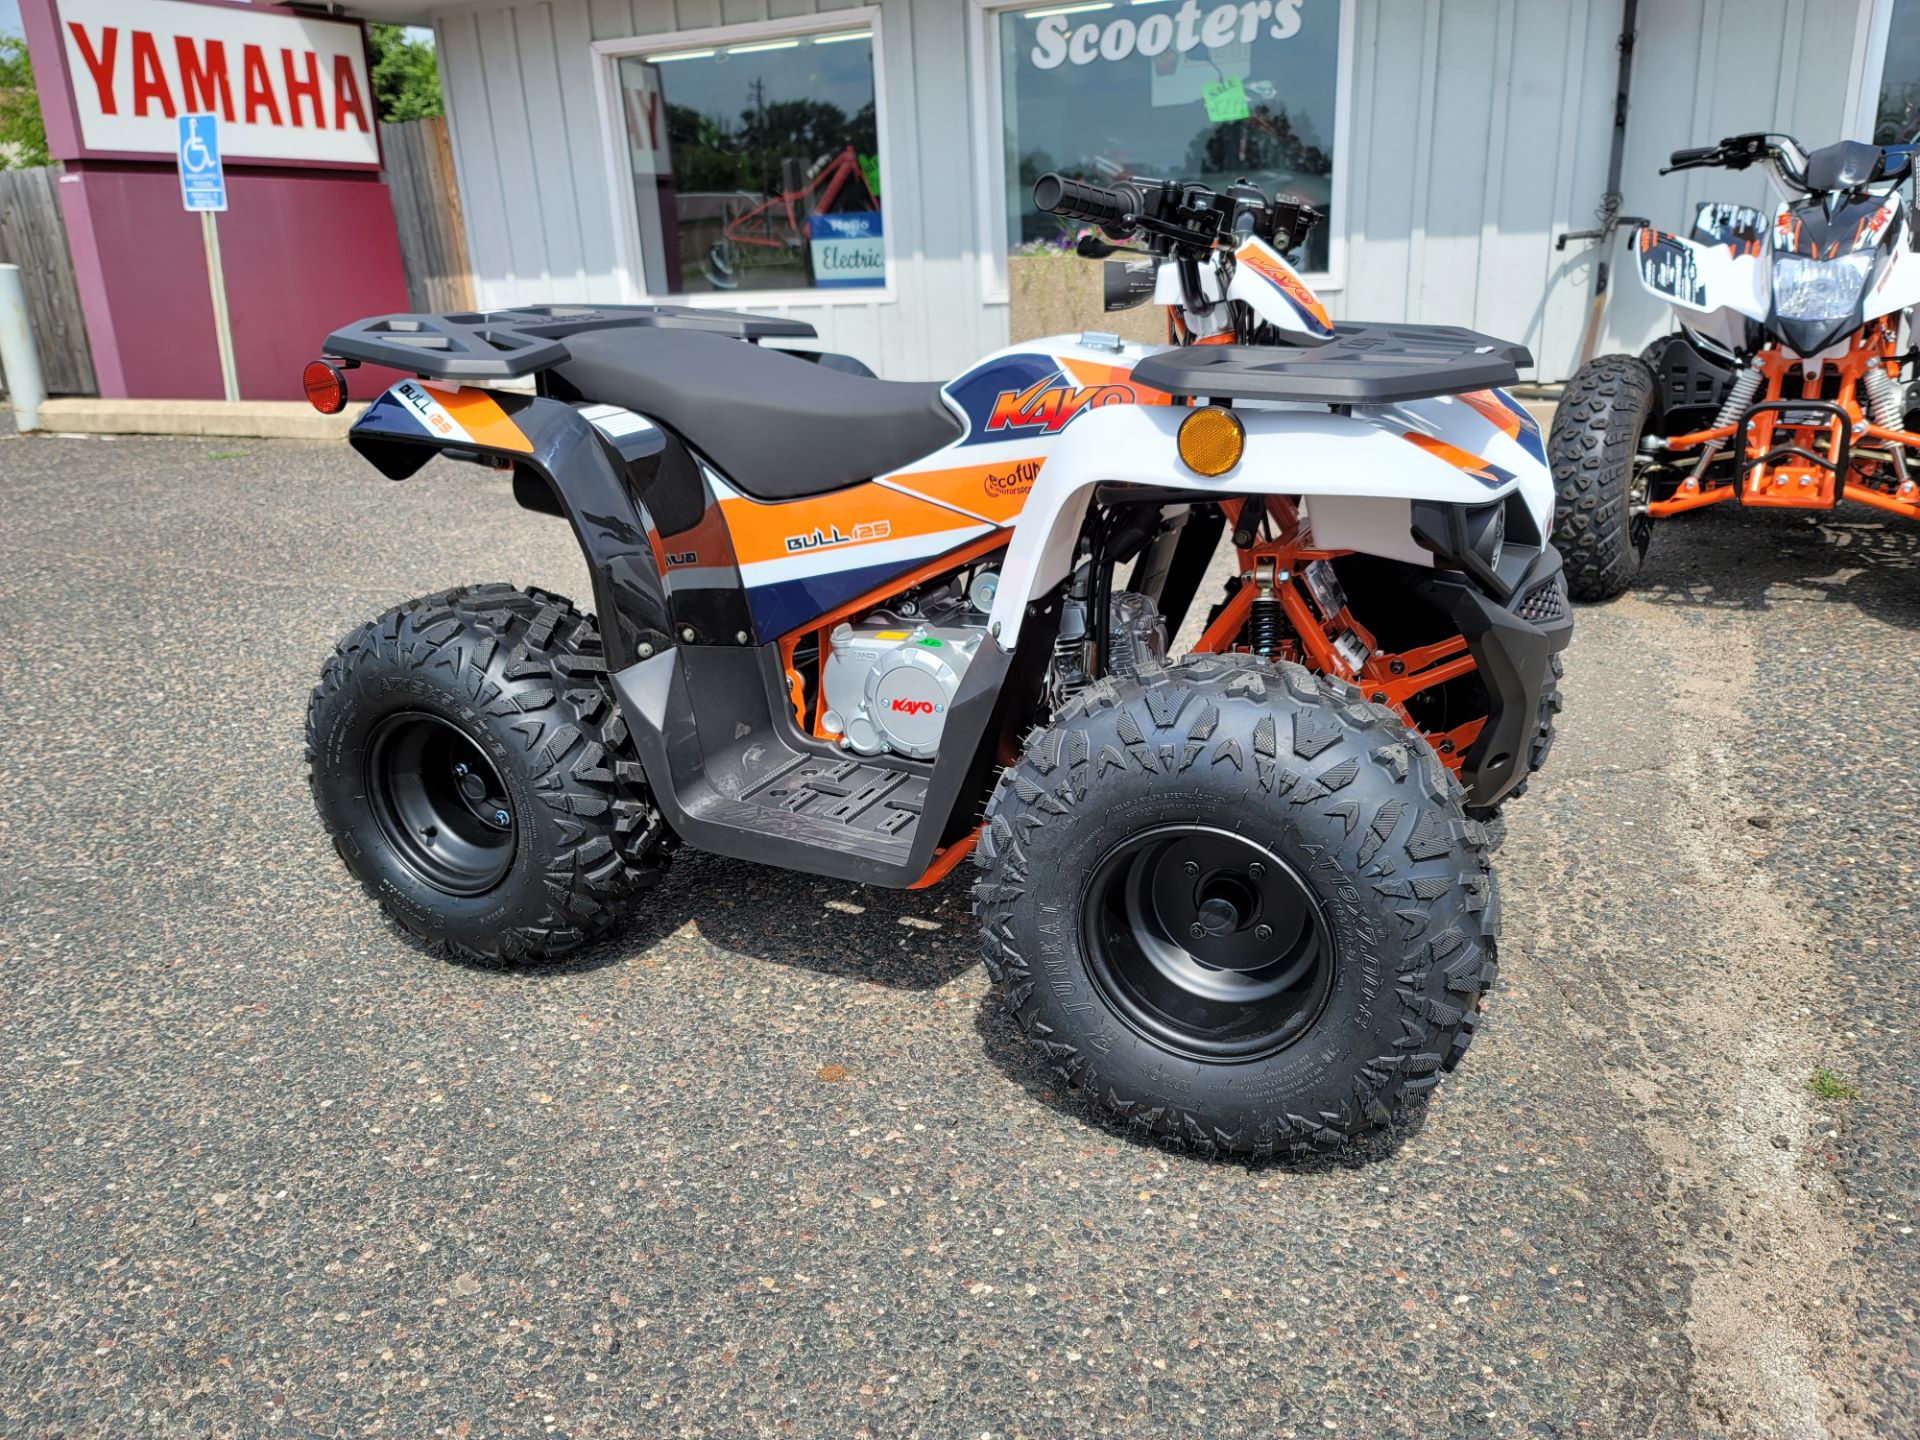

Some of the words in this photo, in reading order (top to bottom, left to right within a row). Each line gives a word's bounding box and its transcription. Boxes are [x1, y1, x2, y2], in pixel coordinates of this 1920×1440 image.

[1031, 0, 1302, 69] Scooters
[67, 21, 370, 134] YAMAHA
[398, 383, 432, 416] BULL
[427, 412, 454, 435] 125
[785, 524, 852, 552] BULL
[852, 521, 892, 540] 125
[892, 697, 933, 715] KAYO
